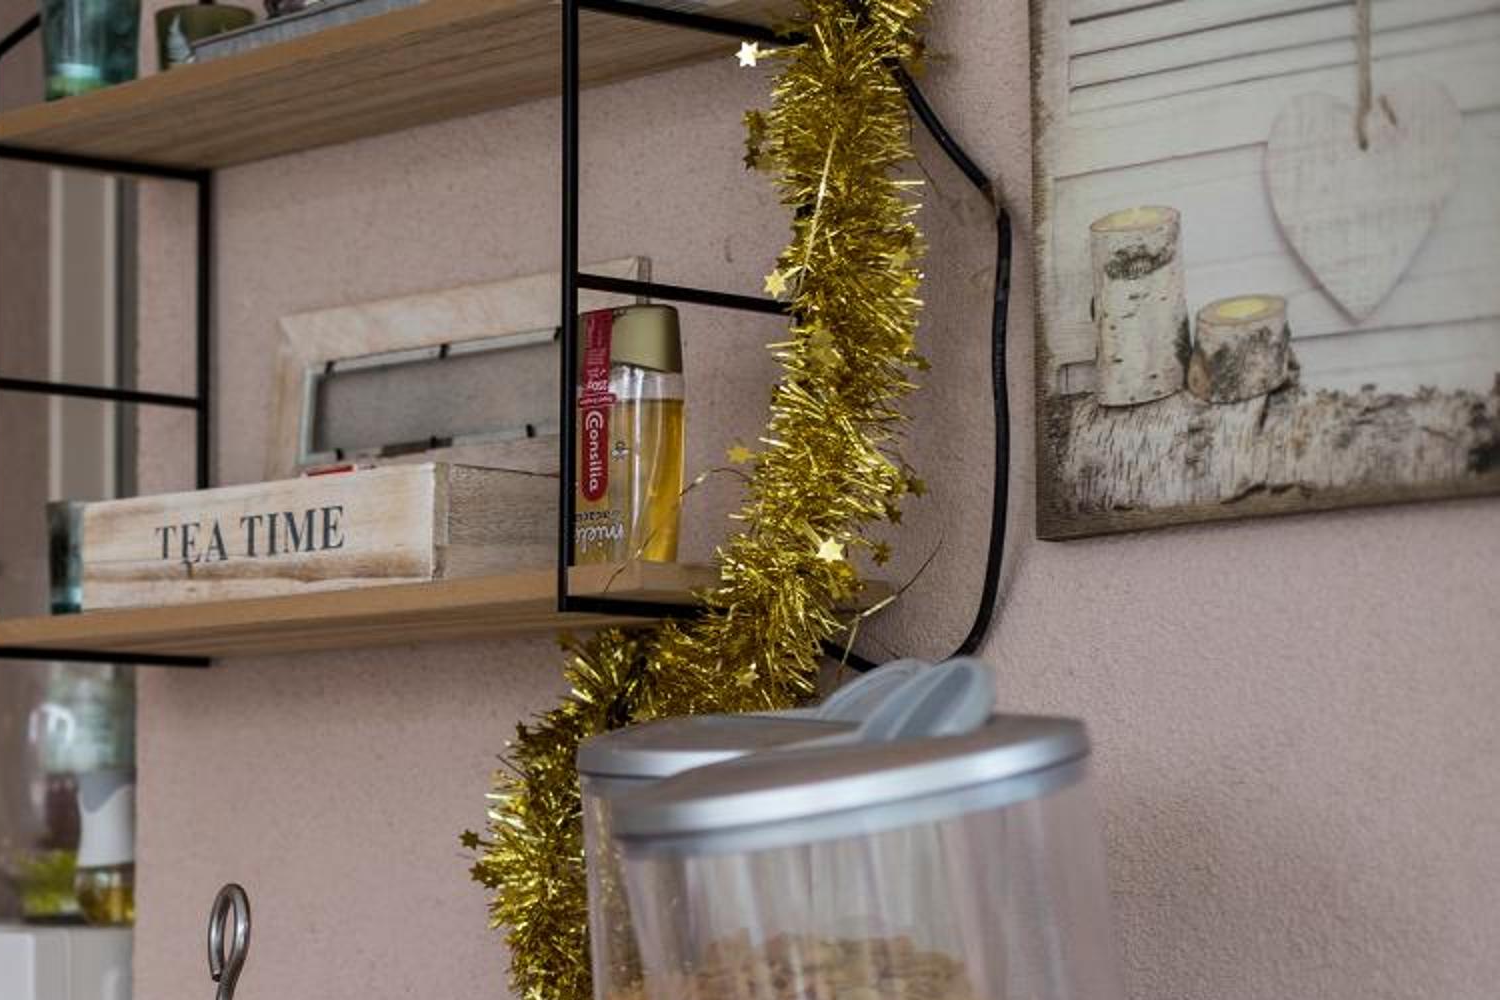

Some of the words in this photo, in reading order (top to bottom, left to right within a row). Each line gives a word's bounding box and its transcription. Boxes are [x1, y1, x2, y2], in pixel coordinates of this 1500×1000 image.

[585, 411, 605, 493] Consilia
[155, 521, 229, 563] TEA
[240, 505, 344, 558] TIME
